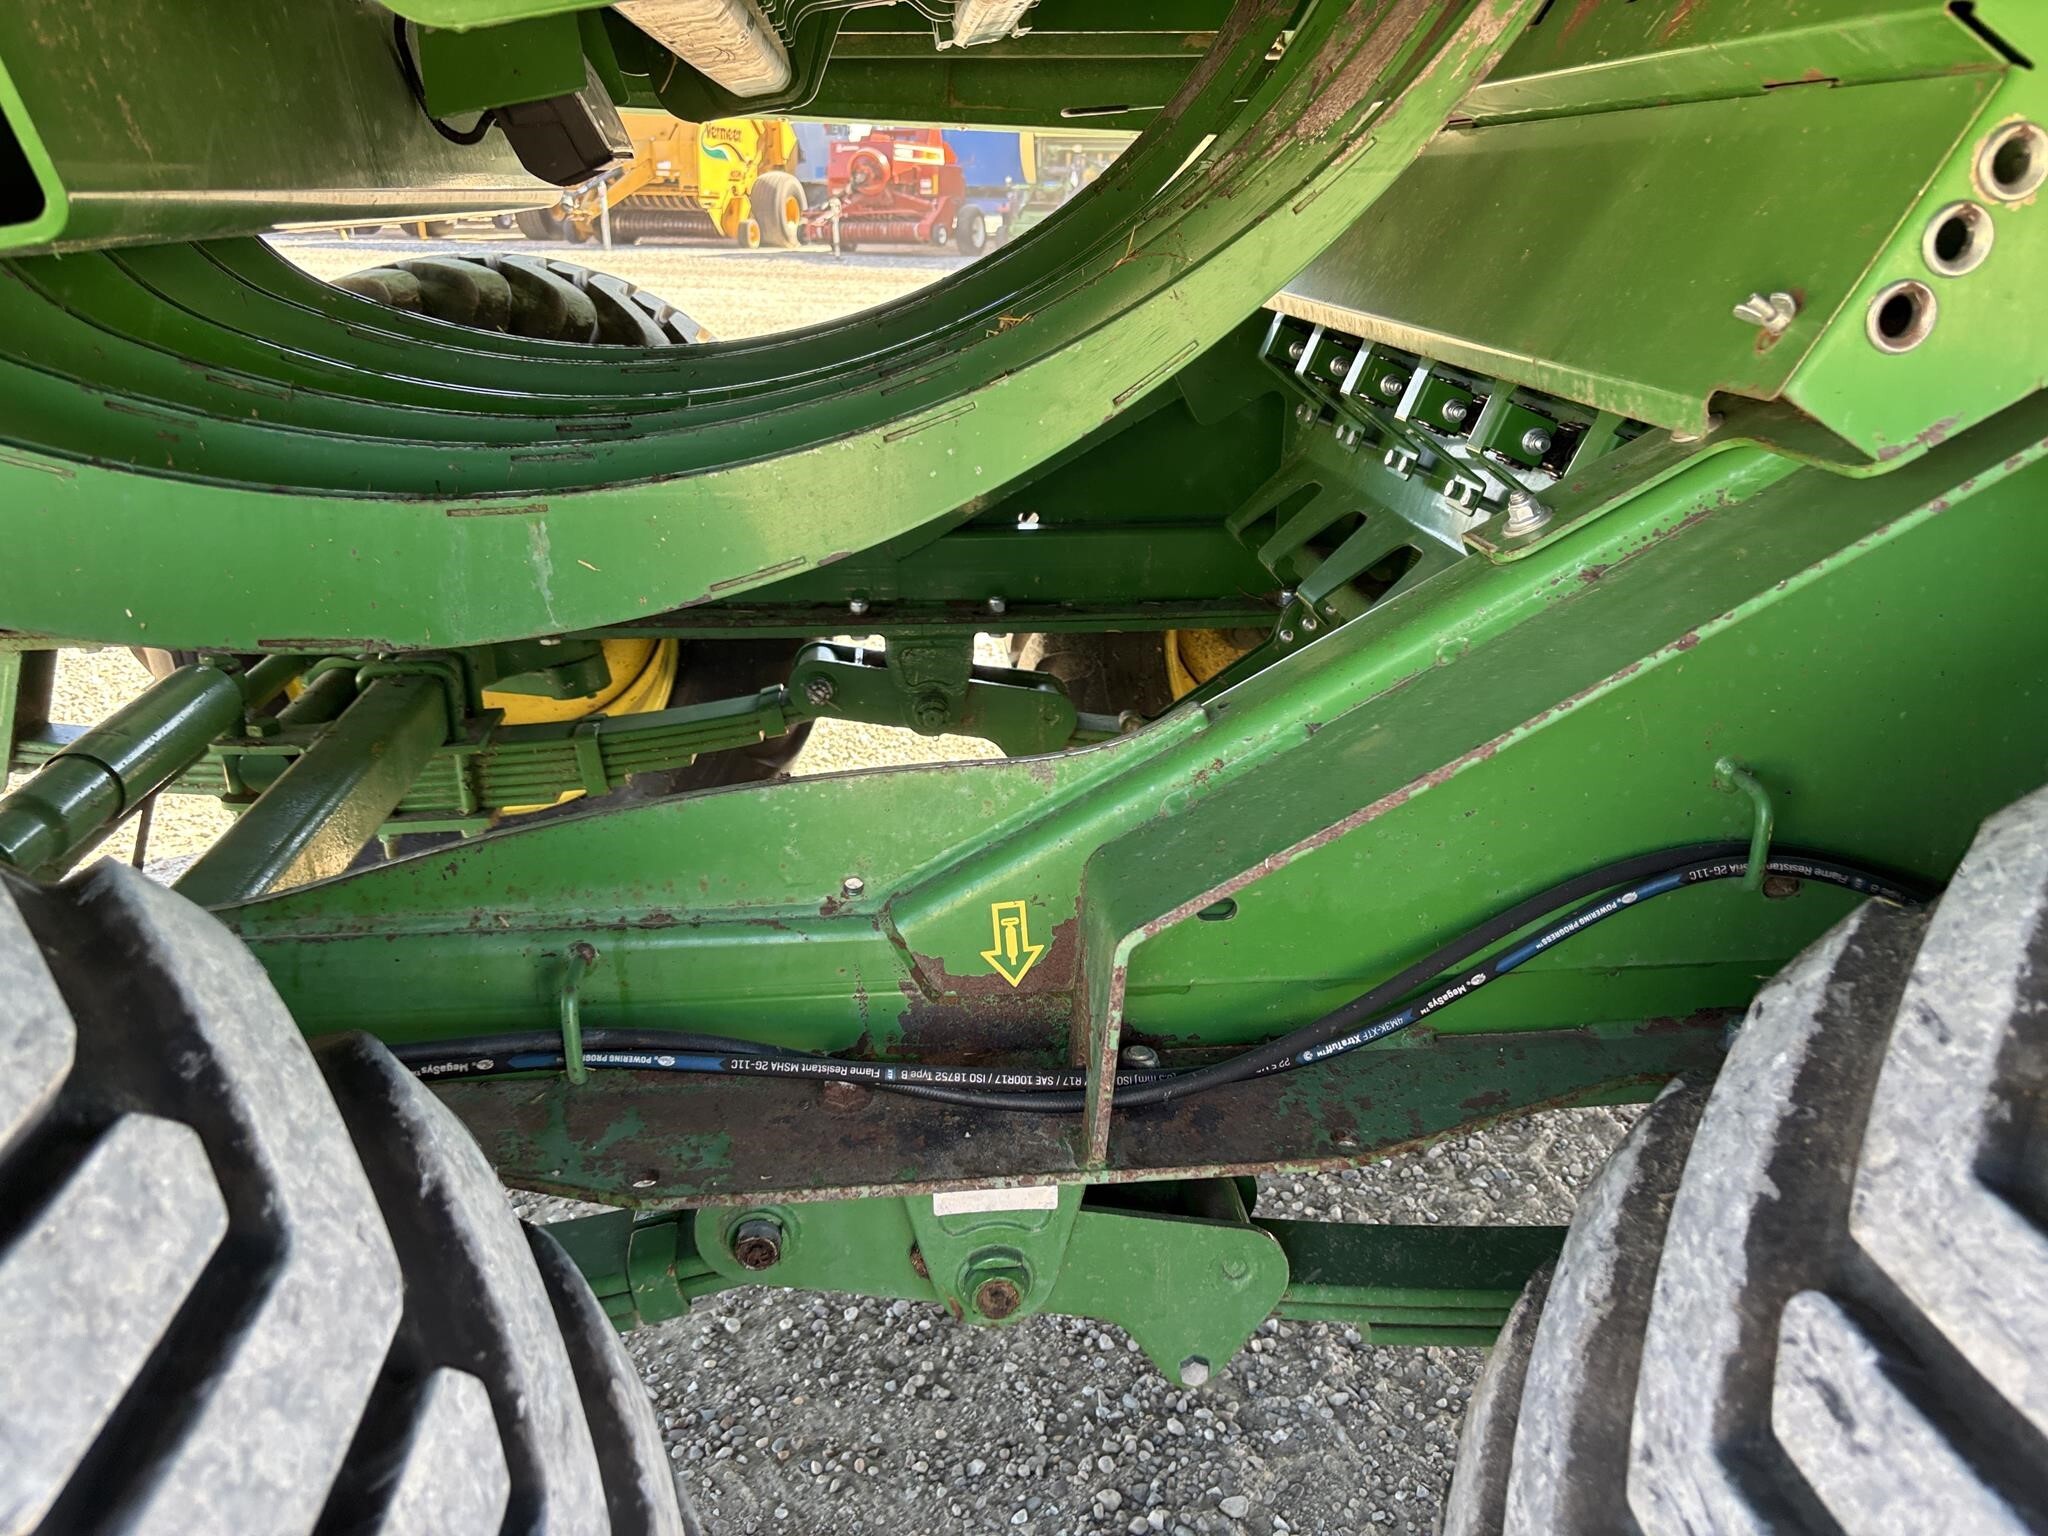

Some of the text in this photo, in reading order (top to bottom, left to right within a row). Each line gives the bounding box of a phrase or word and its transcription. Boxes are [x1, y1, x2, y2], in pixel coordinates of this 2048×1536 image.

[705, 123, 742, 142] Vermeer
[1688, 865, 1728, 881] 2G-11C
[1764, 862, 1812, 876] Resistan
[1579, 901, 1618, 927] POWERING
[609, 1054, 652, 1064] POWERING
[730, 1059, 769, 1071] 2G-11C
[771, 1061, 800, 1072] MSHA
[801, 1063, 848, 1076] Resistant
[850, 1066, 881, 1078] Flame
[901, 1070, 908, 1080] B
[910, 1069, 933, 1081] Type
[935, 1071, 967, 1082] 18752
[969, 1073, 986, 1083] ISO
[994, 1074, 1033, 1086] 100R17
[1035, 1075, 1054, 1086] SAE
[1063, 1076, 1082, 1086] R17
[1116, 1075, 1133, 1087] ISO
